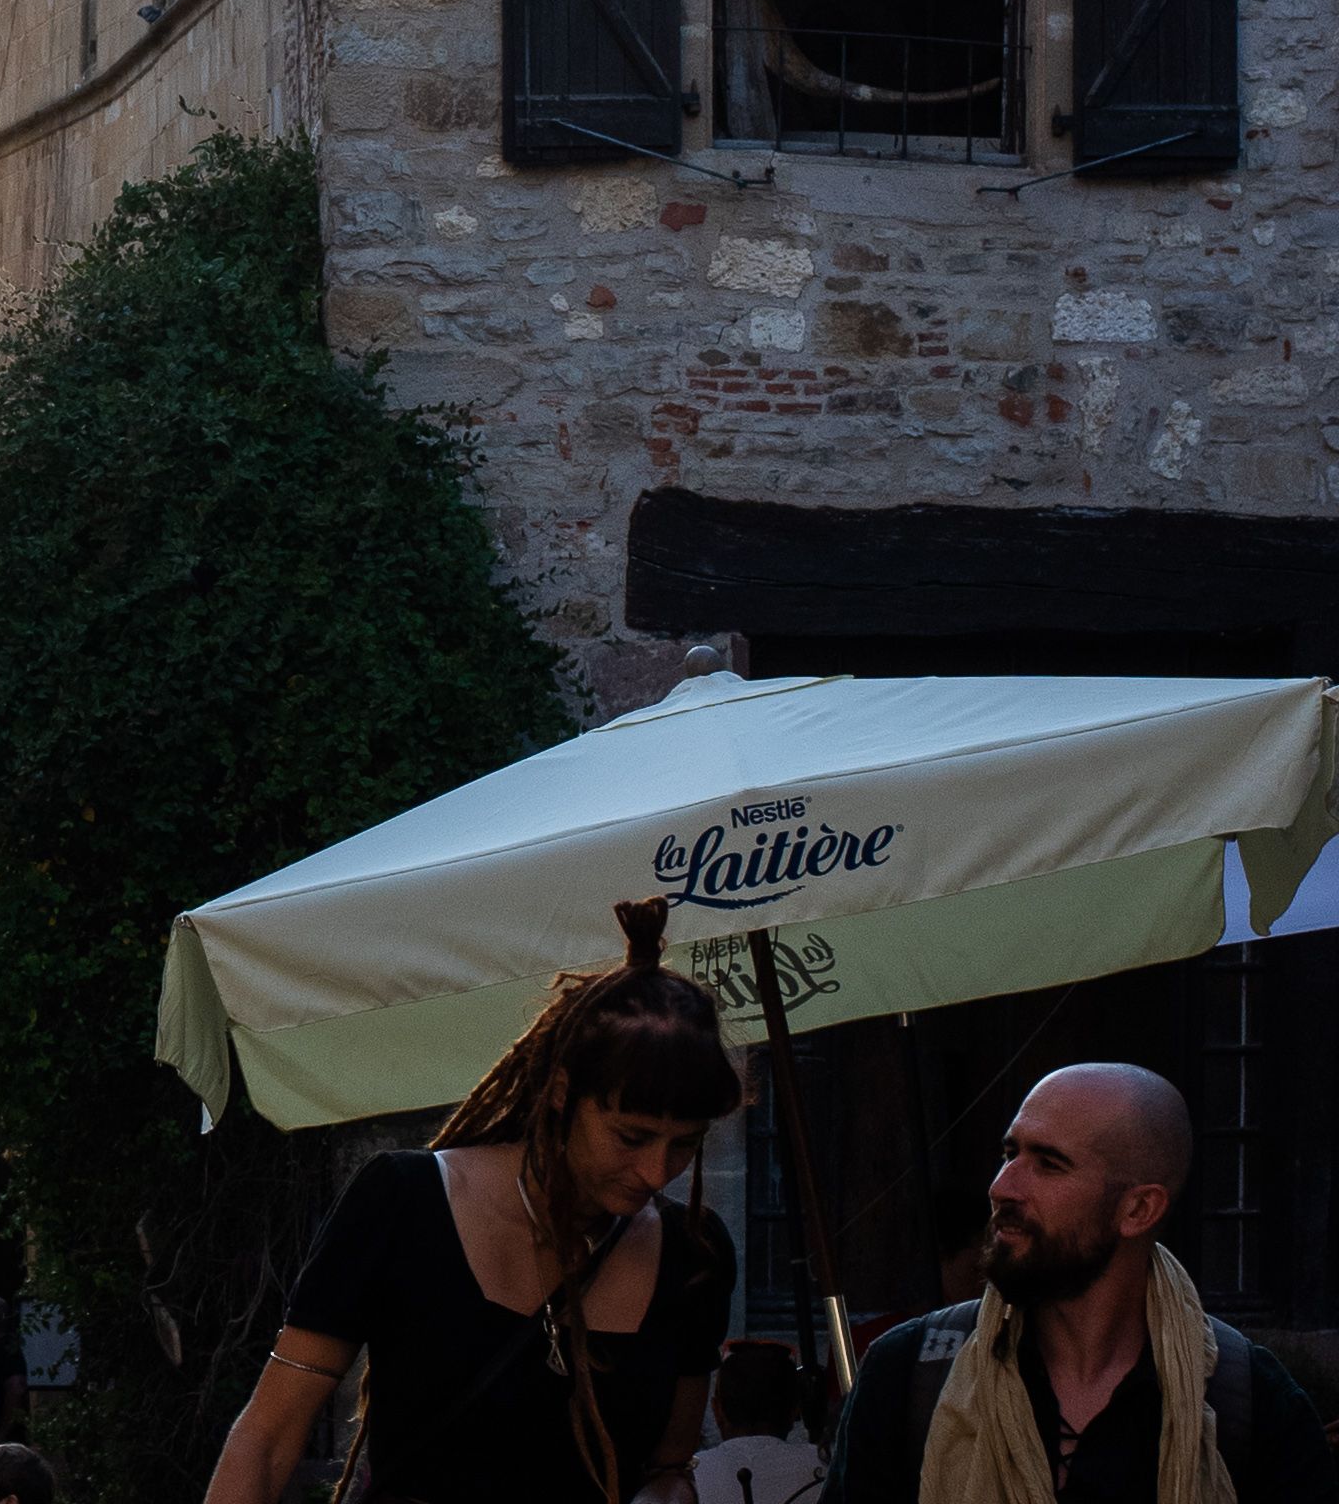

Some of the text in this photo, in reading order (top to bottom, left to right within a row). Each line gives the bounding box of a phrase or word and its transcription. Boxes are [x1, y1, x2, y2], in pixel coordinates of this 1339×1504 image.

[731, 795, 806, 829] Nestlé
[652, 822, 895, 902] la Laitière
